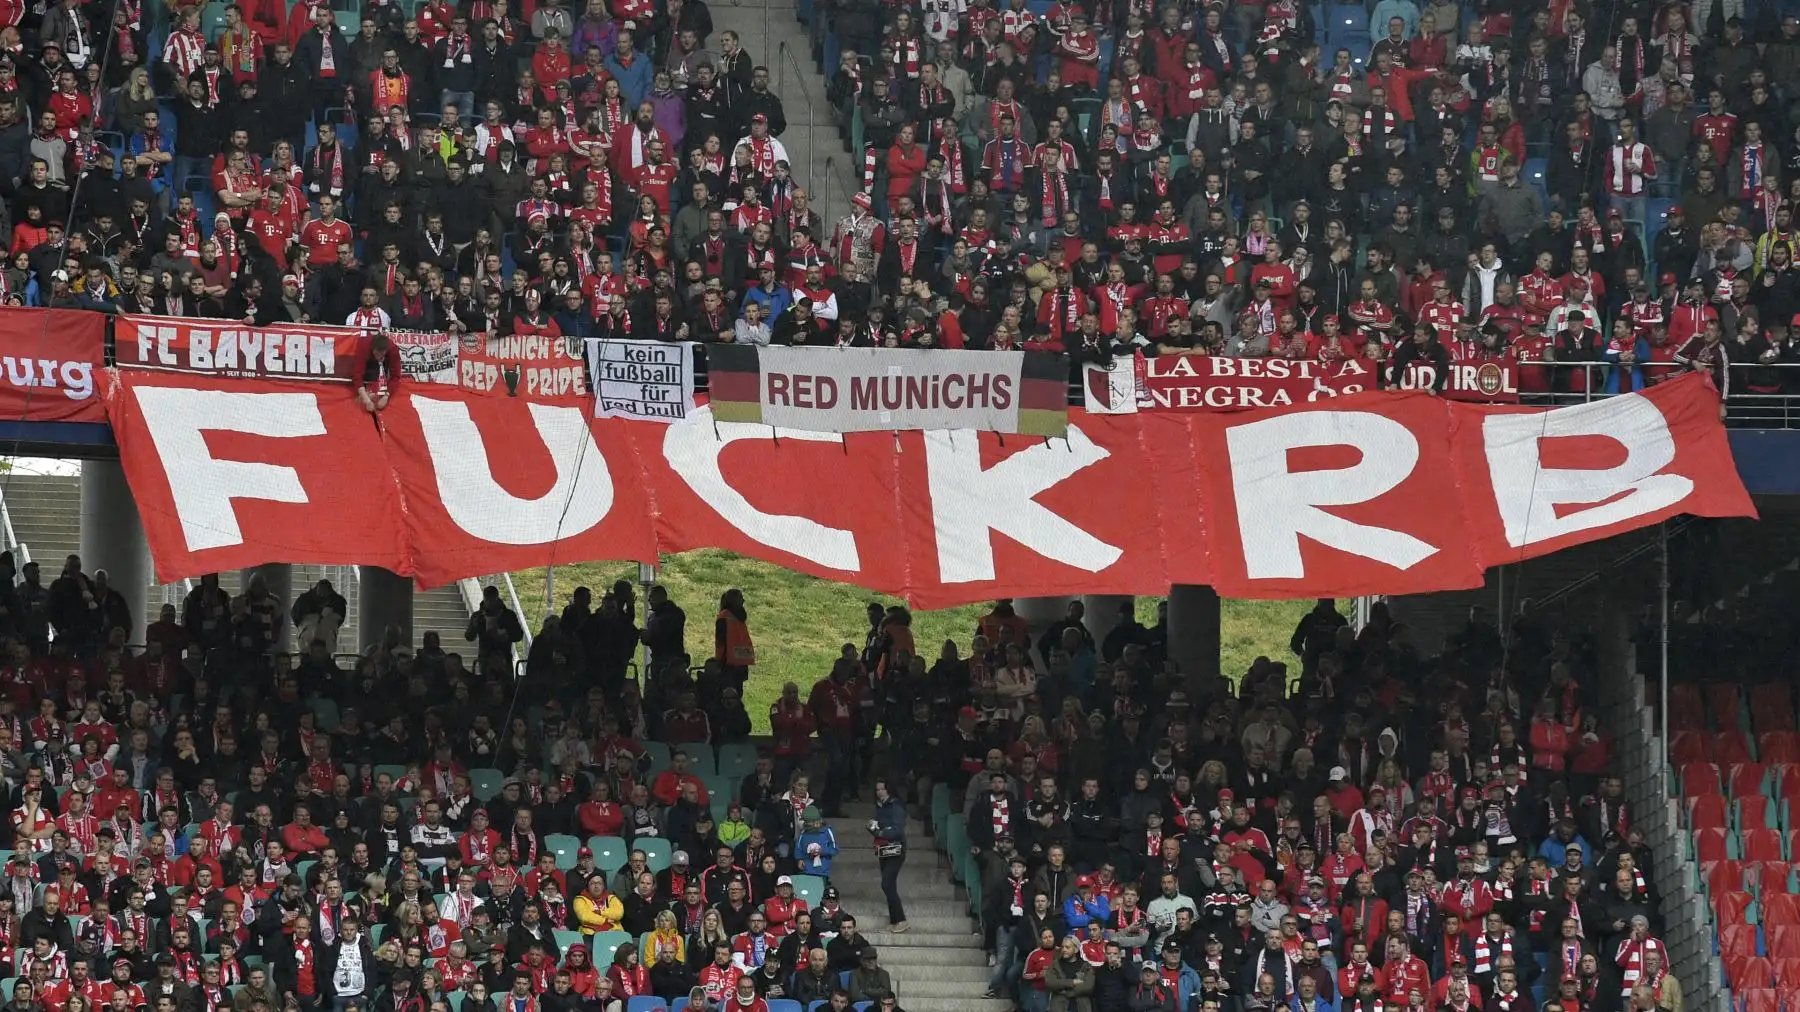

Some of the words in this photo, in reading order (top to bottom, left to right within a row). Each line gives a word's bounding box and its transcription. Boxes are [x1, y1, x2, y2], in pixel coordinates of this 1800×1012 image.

[318, 233, 329, 245] T
[137, 324, 178, 366] FC
[189, 329, 335, 375] BAYERN
[486, 334, 550, 361] MUNICH
[624, 344, 666, 362] kein
[0, 356, 93, 400] urg
[461, 359, 499, 393] RED
[526, 366, 587, 397] PRIDE
[604, 362, 676, 383] fußball
[1144, 356, 1200, 379] LA
[1204, 355, 1368, 379] BESTA
[640, 384, 670, 402] für
[767, 372, 839, 410] RED
[1150, 385, 1293, 409] NEGRA
[643, 402, 682, 417] bull
[133, 385, 1123, 584] FUCK
